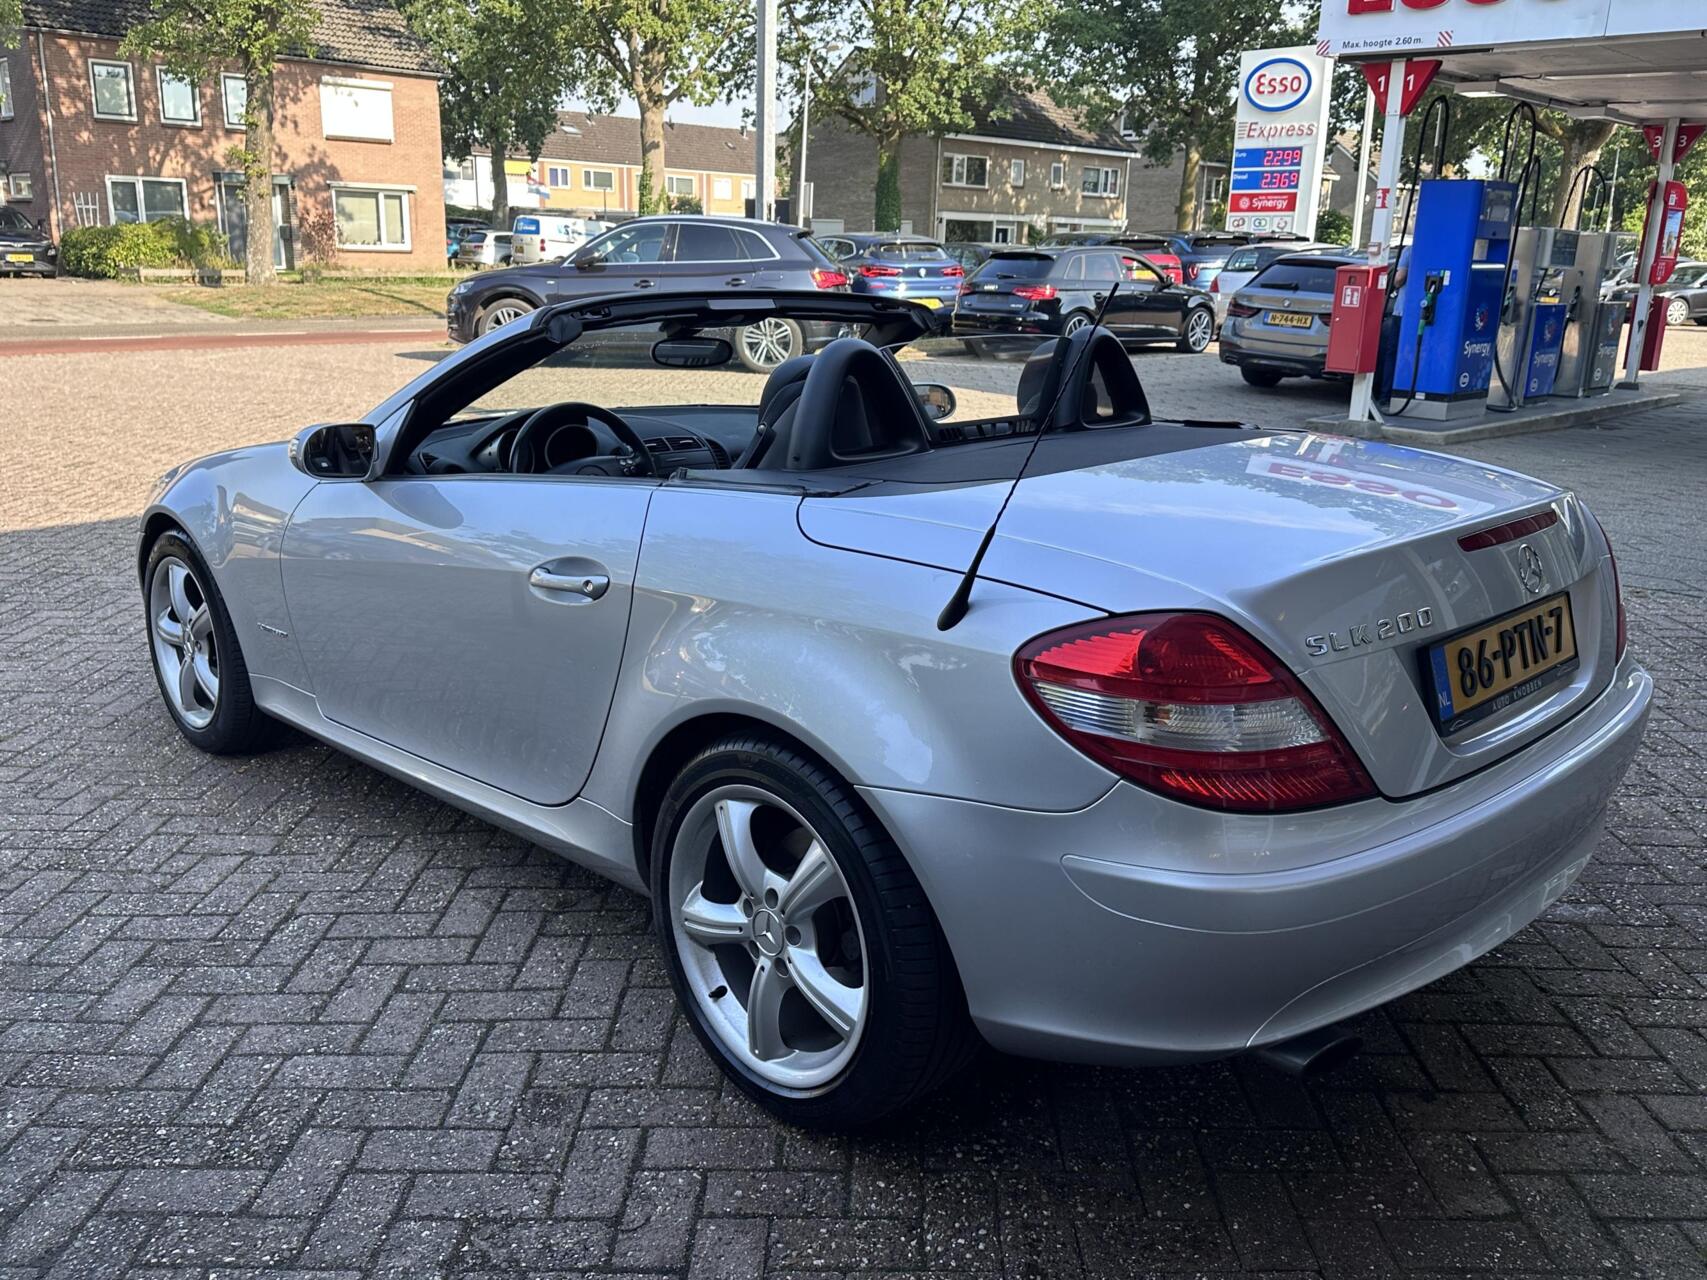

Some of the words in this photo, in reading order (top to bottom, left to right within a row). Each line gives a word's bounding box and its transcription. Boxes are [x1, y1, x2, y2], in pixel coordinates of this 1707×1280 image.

[1342, 41, 1361, 49] Max.
[1363, 39, 1392, 48] hoogte
[1395, 36, 1412, 46] 2.60
[1255, 72, 1302, 95] Esso
[1377, 75, 1386, 92] 1
[1406, 73, 1415, 91] 1
[1246, 120, 1315, 141] Express
[1653, 135, 1662, 147] 3
[1678, 135, 1688, 148] 3
[1263, 150, 1301, 166] 2.299
[1261, 172, 1298, 188] 2.369
[1252, 198, 1289, 210] Synergy
[1270, 313, 1309, 326] N-744-HX
[1463, 340, 1492, 358] Synergy
[1533, 351, 1557, 368] Synergy
[1305, 622, 1372, 657] SLK
[1377, 606, 1433, 641] 200
[1457, 606, 1564, 699] 86-PTN-7
[1438, 691, 1451, 707] NL
